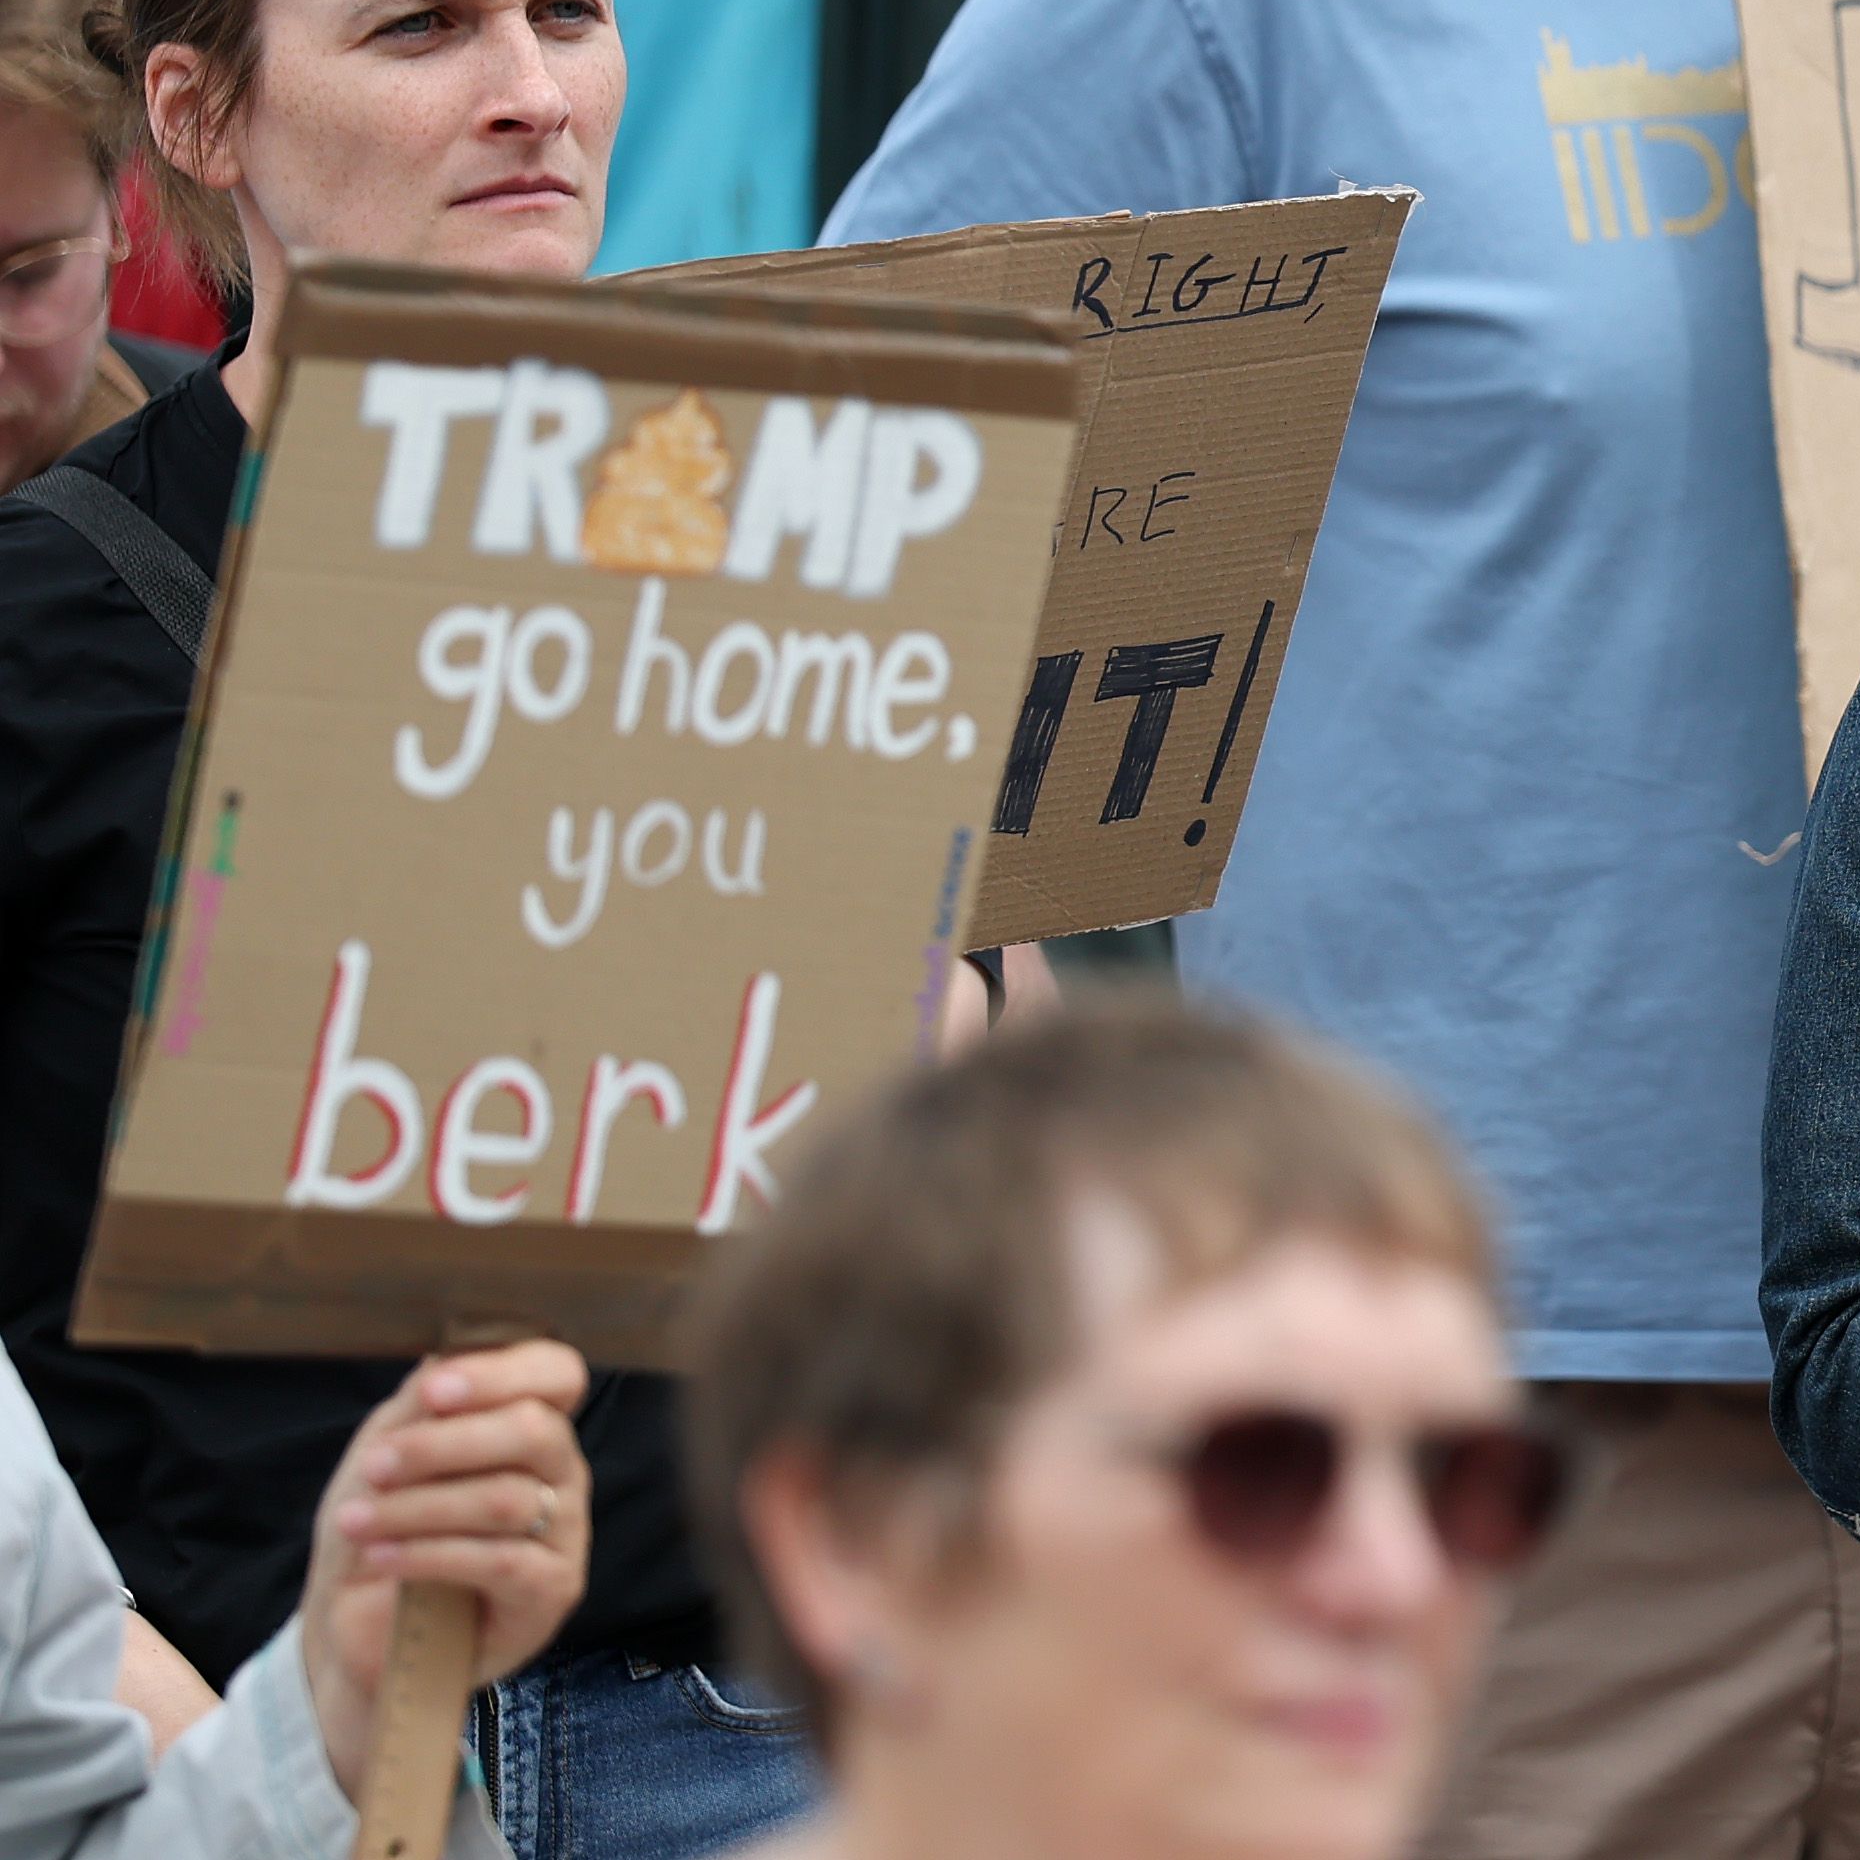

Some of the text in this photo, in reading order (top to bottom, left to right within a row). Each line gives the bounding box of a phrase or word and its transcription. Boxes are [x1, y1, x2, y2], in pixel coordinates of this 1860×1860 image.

[1072, 246, 1347, 330] RIGHT,
[394, 578, 976, 799] go home,
[522, 800, 765, 947] you
[285, 943, 816, 1237] berk
